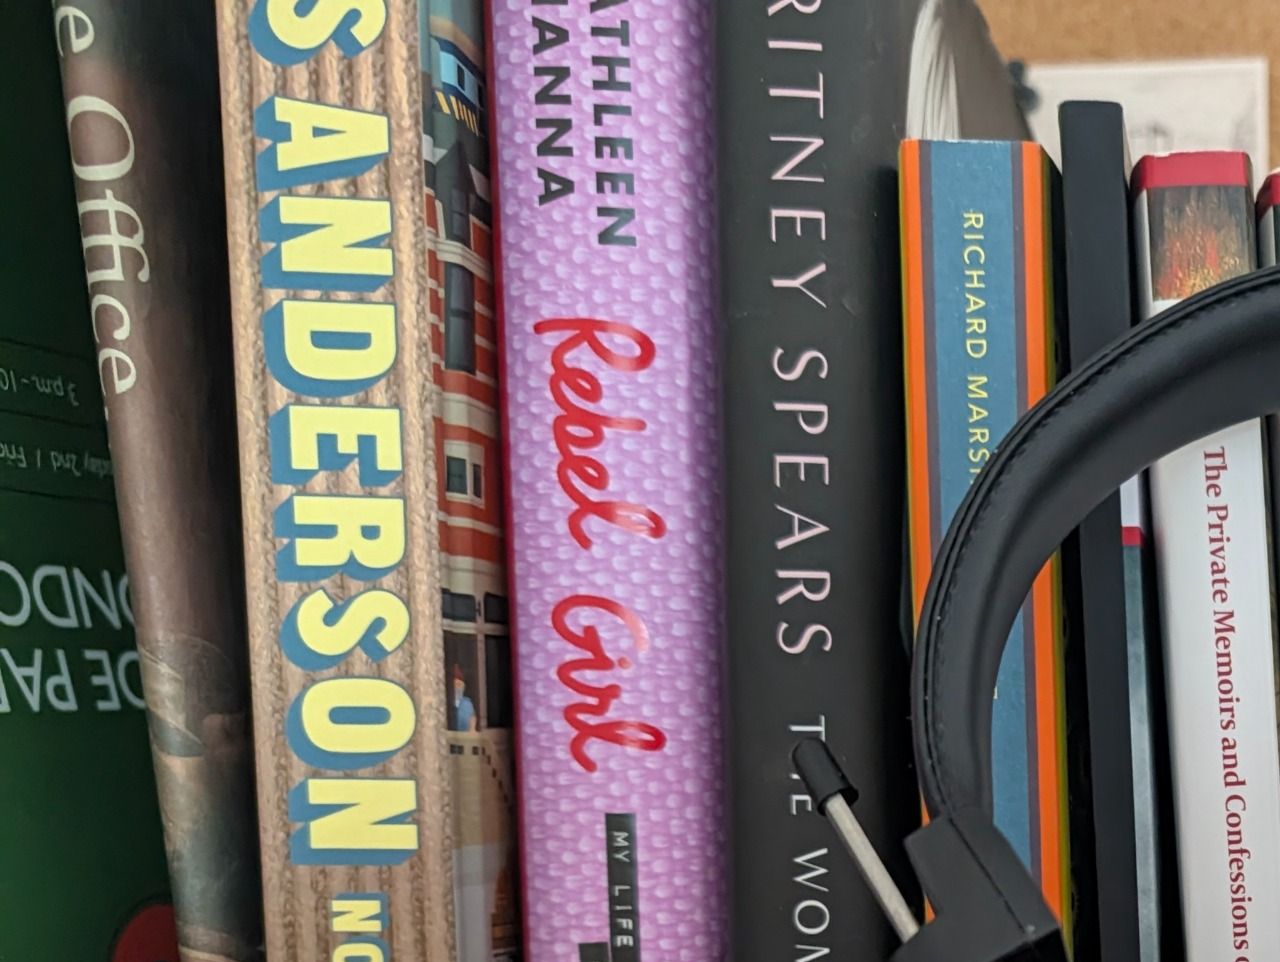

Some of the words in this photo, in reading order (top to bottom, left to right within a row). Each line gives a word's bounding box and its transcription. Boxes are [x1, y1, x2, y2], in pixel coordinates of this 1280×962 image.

[531, 0, 576, 207] ANNA
[962, 209, 987, 360] RICHARD
[256, 97, 419, 866] ANDERSON
[532, 316, 667, 551] Rebel
[966, 374, 991, 485] MARS
[1203, 446, 1228, 498] The
[771, 346, 833, 655] SPEARS
[1206, 504, 1232, 604] Private
[0, 648, 79, 713] PA
[550, 593, 667, 774] Girl
[1213, 609, 1241, 731] Memoirs
[1221, 736, 1247, 789] and
[612, 831, 631, 863] MY
[1225, 794, 1253, 951] Confessions
[614, 884, 635, 948] LIFE
